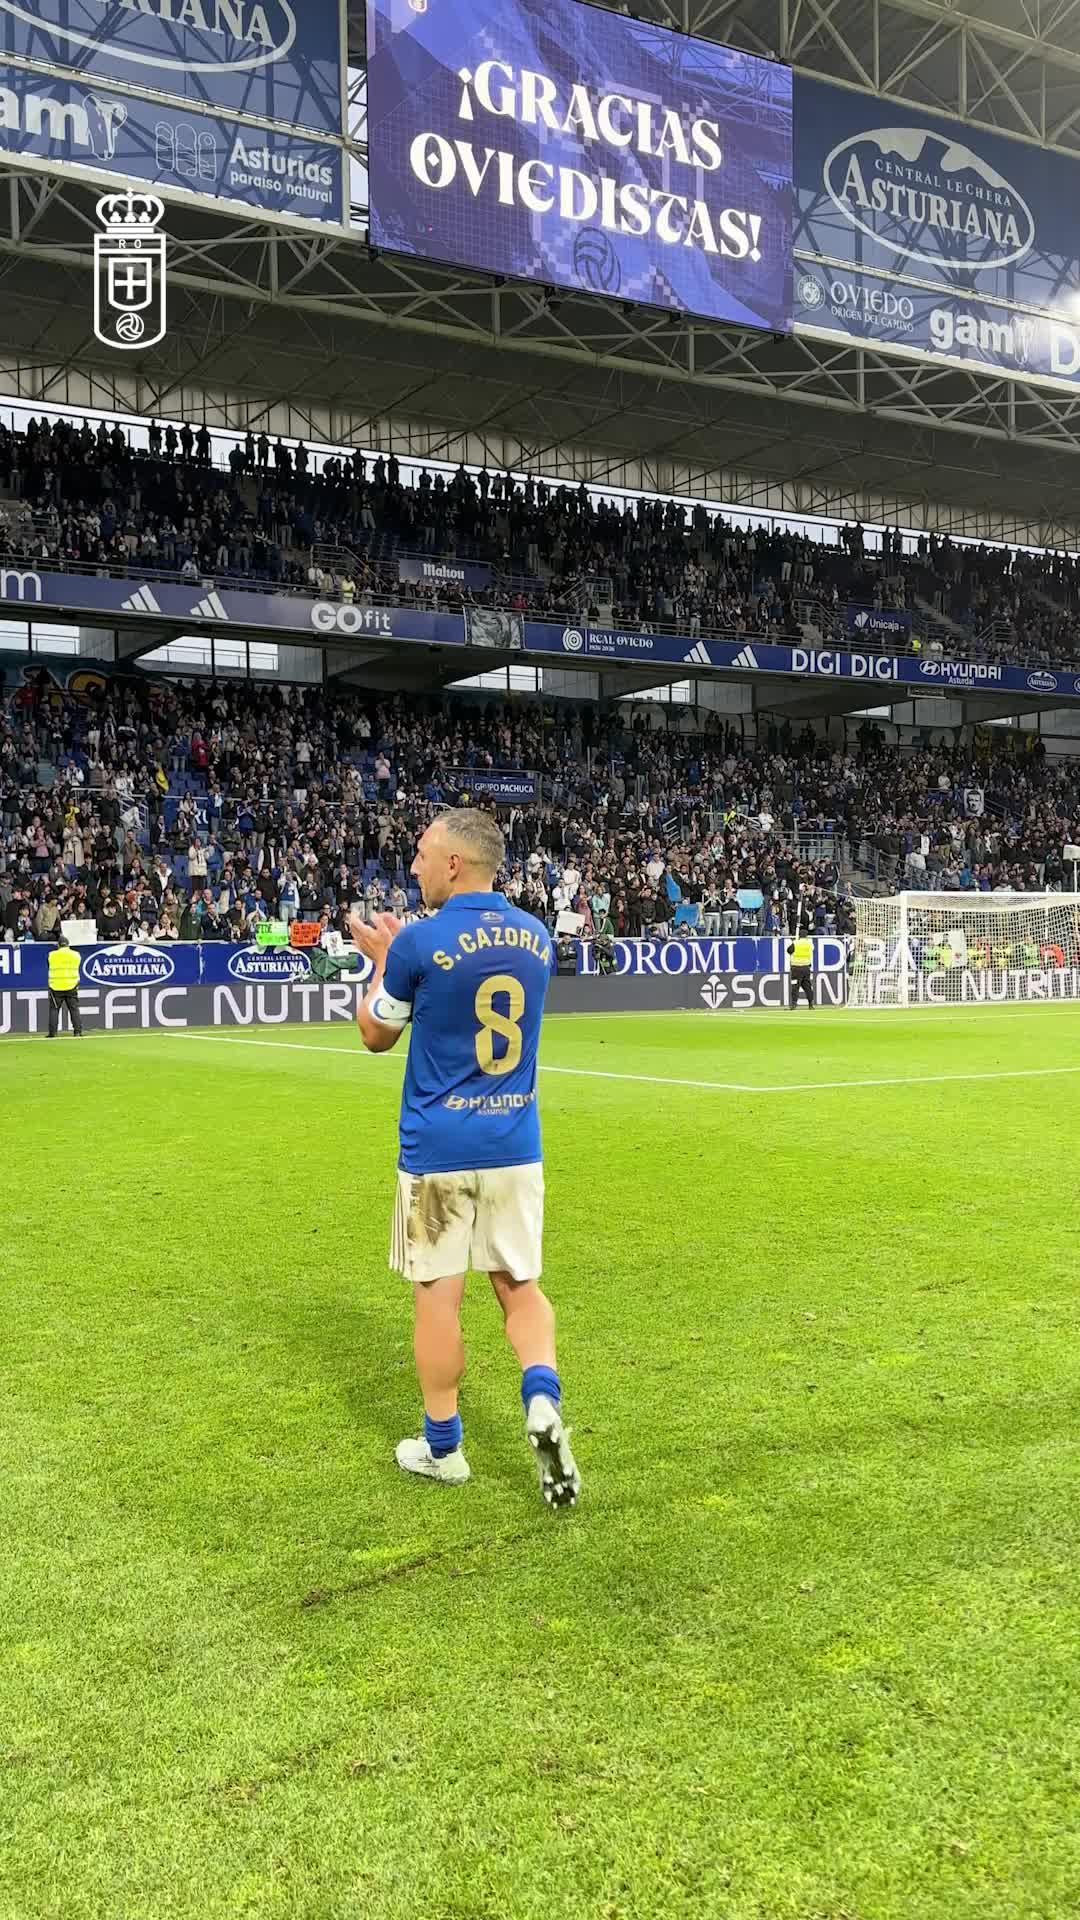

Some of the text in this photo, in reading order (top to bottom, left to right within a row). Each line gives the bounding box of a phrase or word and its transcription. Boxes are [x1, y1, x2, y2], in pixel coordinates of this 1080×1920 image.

[458, 60, 722, 171] ¡GRACIAS
[230, 137, 333, 185] Asturias
[286, 183, 333, 204] natural
[410, 132, 762, 262] OVIEDISTAS!
[875, 159, 1012, 207] CENTRAL LECHERA
[839, 153, 1022, 248] ASTURIANA
[831, 281, 914, 319] OVIEDO
[831, 305, 914, 333] ORIGEN DEL CAMINO
[930, 308, 1014, 354] gam
[423, 563, 465, 580] Mahou
[589, 632, 654, 649] REAL OVIEDO
[870, 618, 900, 633] Unicaja
[792, 649, 898, 680] DIGI DIGI
[940, 662, 1002, 681] HYUNDAI
[500, 784, 534, 793] PACHUCA
[458, 927, 550, 966] CAZORLA
[90, 959, 169, 976] ASTURIANA
[235, 956, 309, 974] ASTURIANA
[474, 974, 525, 1075] 8
